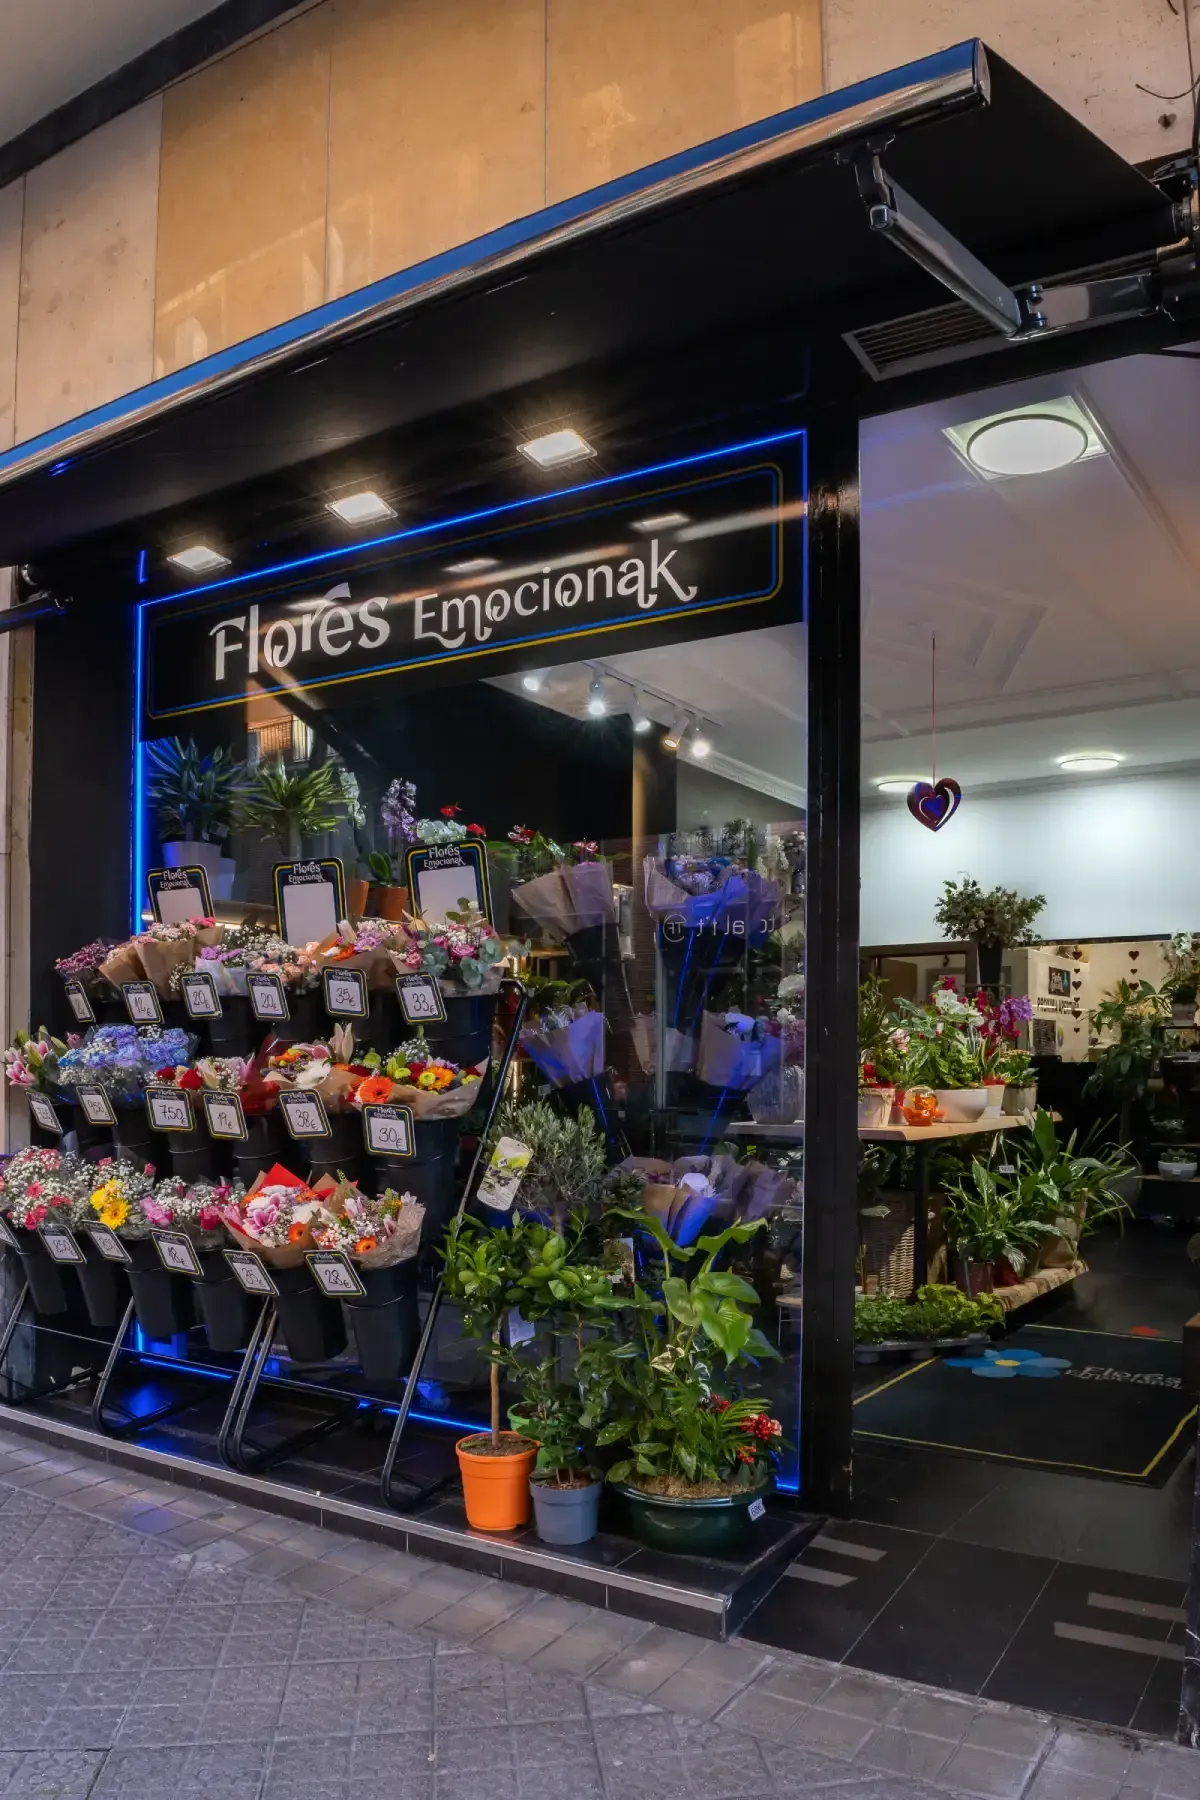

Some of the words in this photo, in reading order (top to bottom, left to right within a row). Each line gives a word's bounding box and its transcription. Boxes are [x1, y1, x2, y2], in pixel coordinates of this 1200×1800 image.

[414, 539, 698, 649] Emocionak
[424, 855, 466, 869] Emocionak
[192, 990, 211, 1009] 20€
[260, 992, 279, 1012] 20€
[336, 987, 357, 1008] 35€
[412, 993, 437, 1016] 33€
[215, 1111, 233, 1130] 19€
[294, 1109, 318, 1131] 38€
[378, 1127, 405, 1150] 30€
[325, 1269, 351, 1289] 28€
